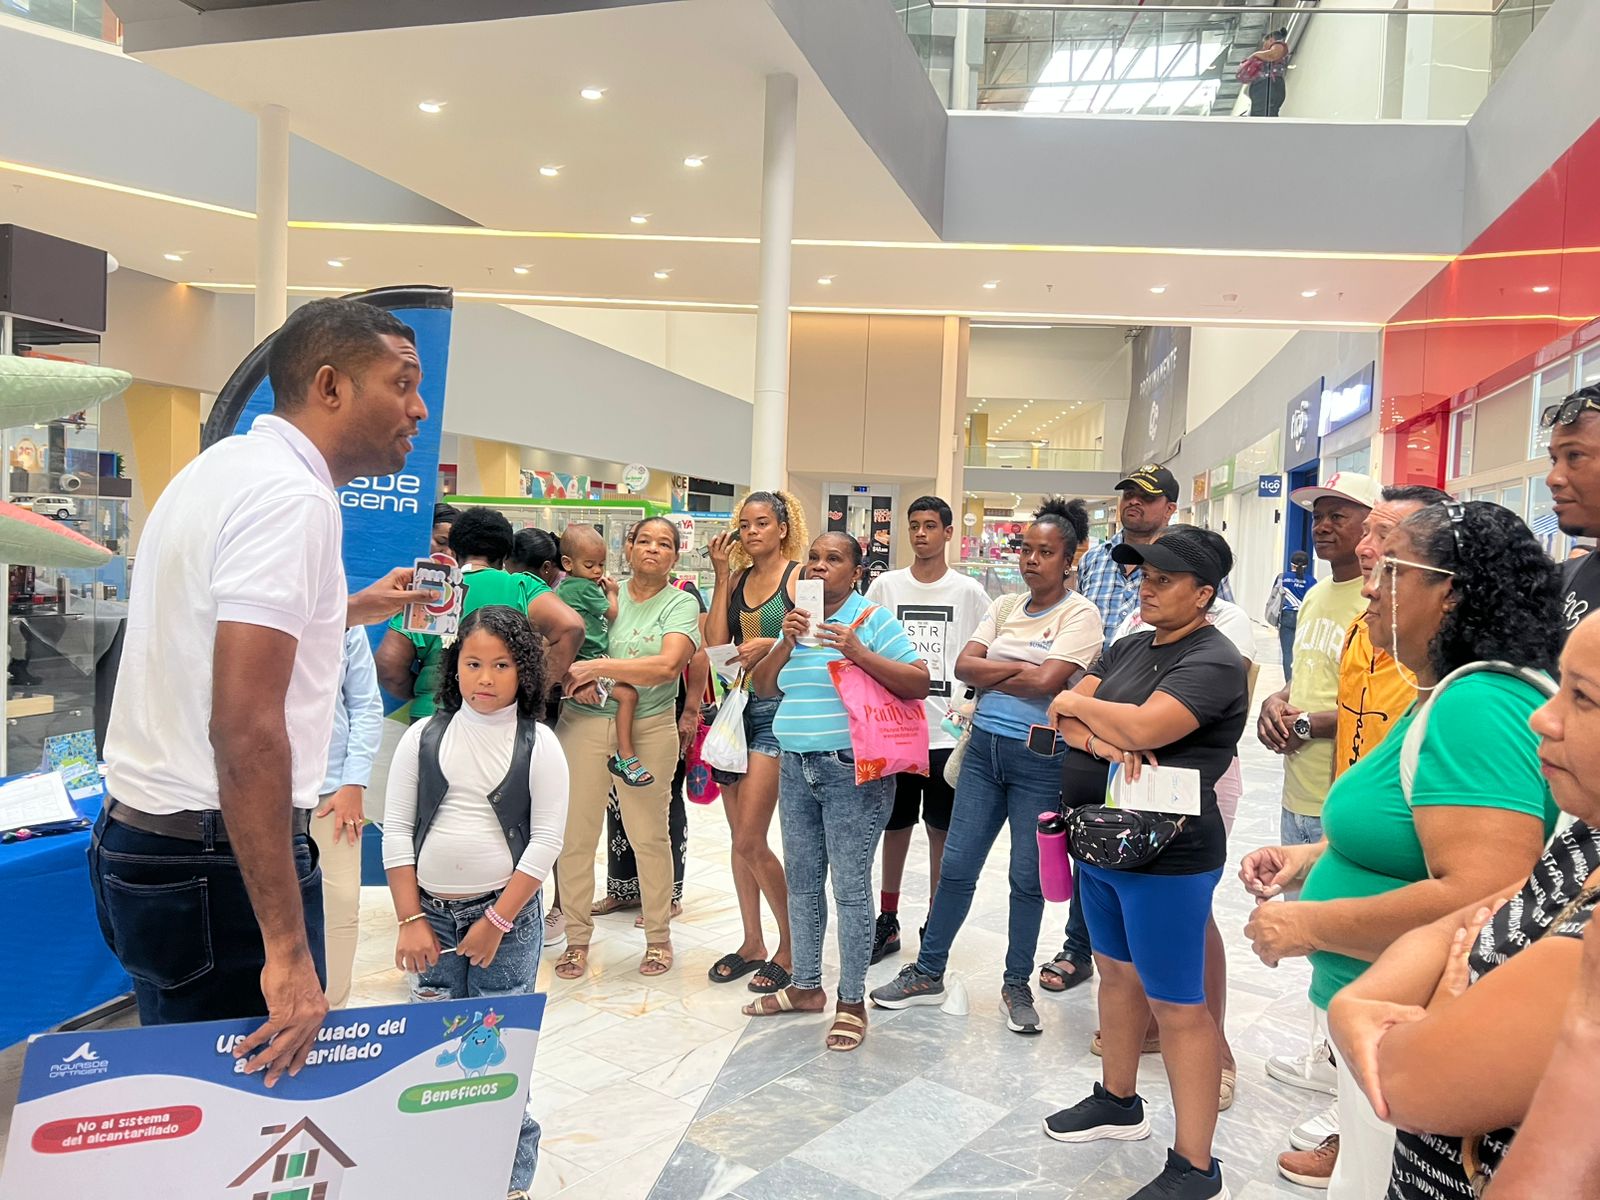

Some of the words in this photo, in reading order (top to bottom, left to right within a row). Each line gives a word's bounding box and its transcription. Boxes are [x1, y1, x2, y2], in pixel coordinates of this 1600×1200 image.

[907, 625, 939, 637] STR
[216, 1034, 246, 1054] Us
[377, 1017, 407, 1035] del
[420, 1082, 499, 1106] Beneficios
[76, 1122, 97, 1134] No
[101, 1118, 114, 1130] al
[118, 1113, 171, 1128] sistema
[62, 1135, 83, 1148] del
[87, 1124, 180, 1144] alcantarillado
[1420, 1158, 1475, 1198] FEMINIST
